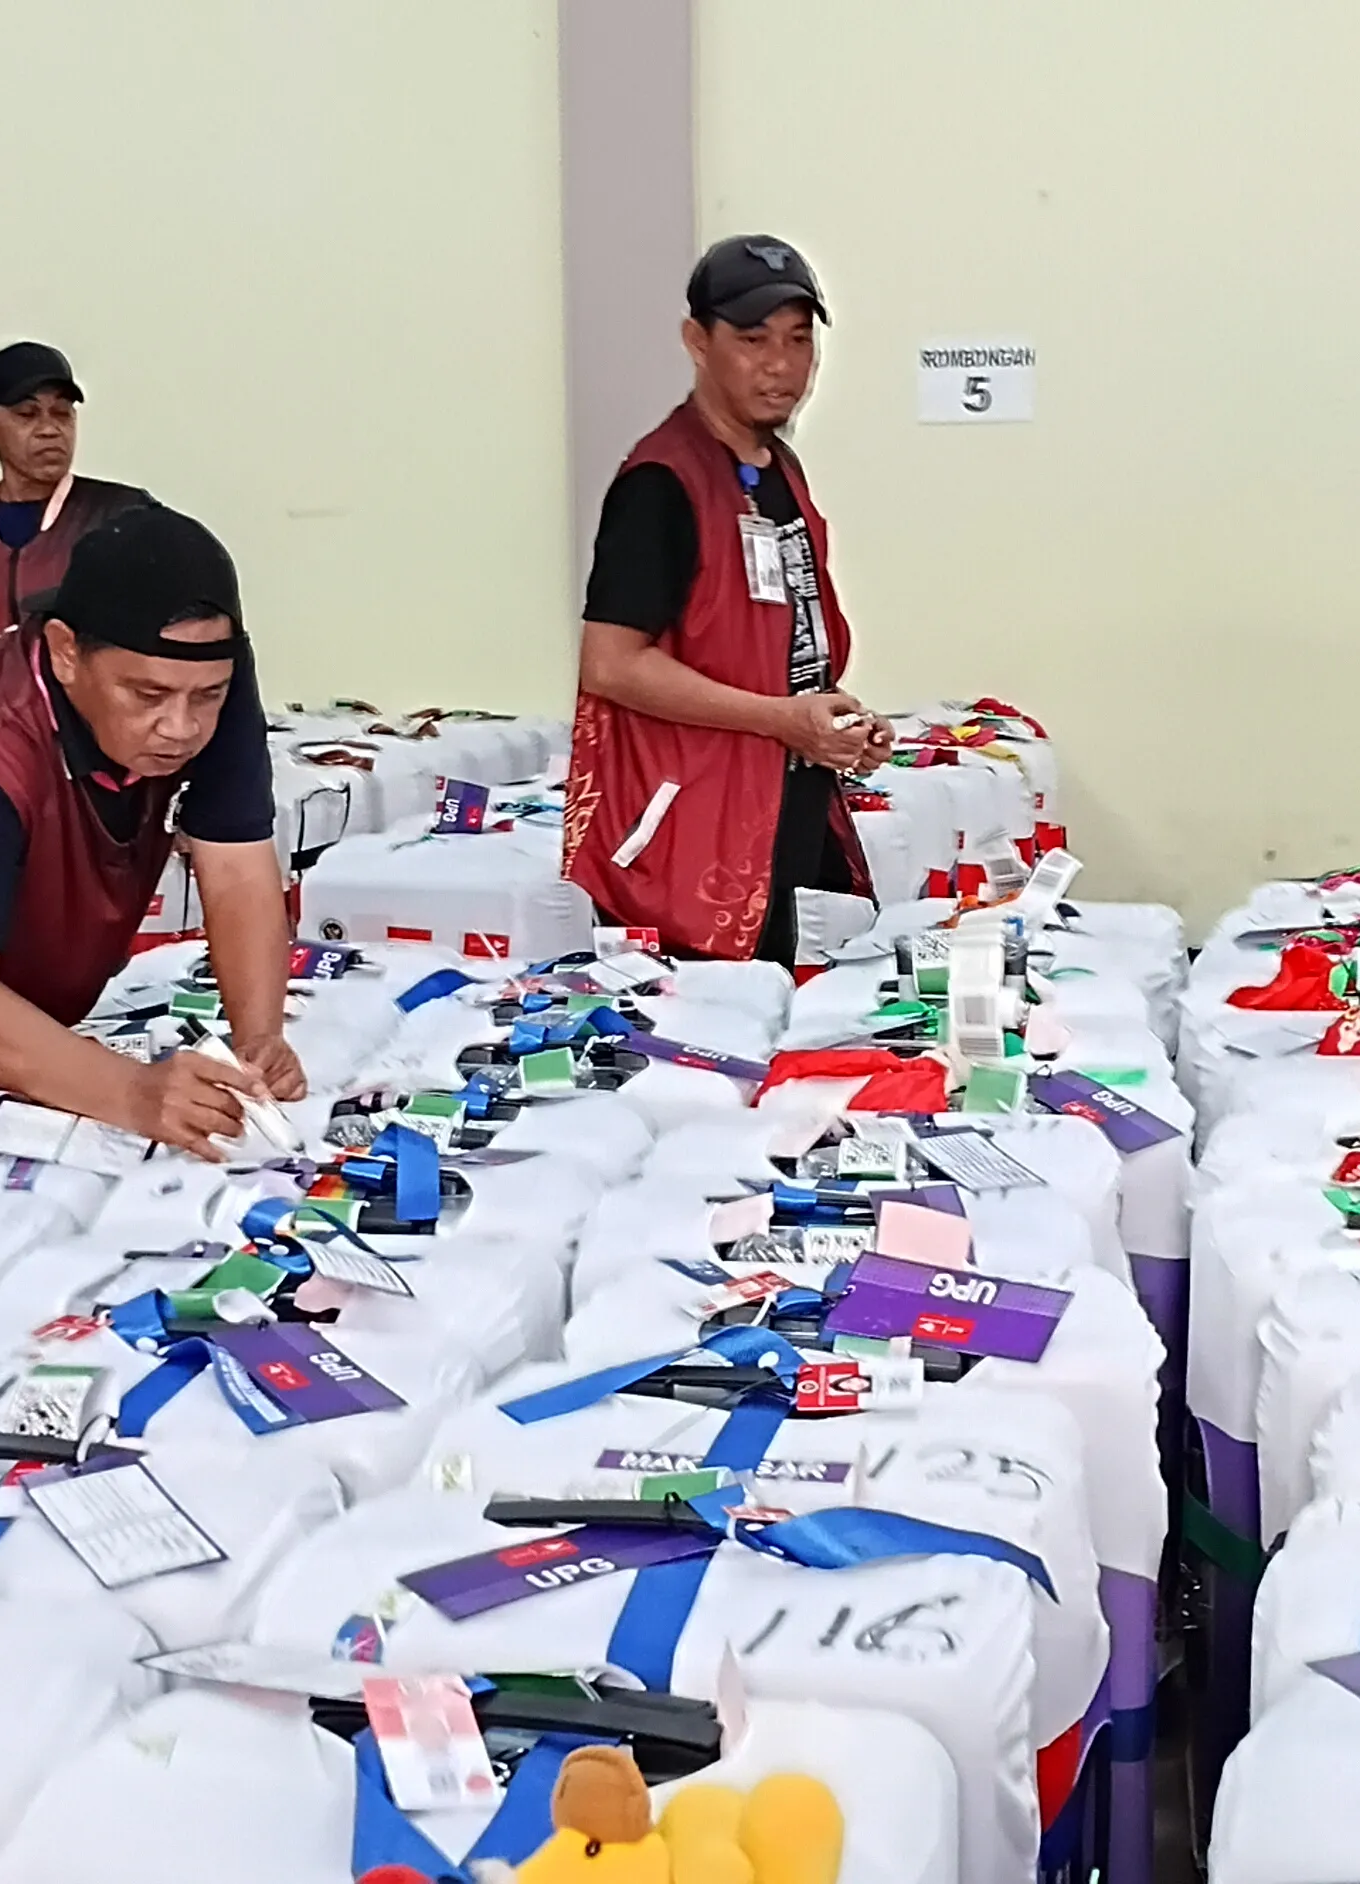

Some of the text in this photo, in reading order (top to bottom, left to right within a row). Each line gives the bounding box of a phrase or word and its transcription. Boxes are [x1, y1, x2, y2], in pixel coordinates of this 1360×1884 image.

[921, 348, 1036, 368] ROMBONGAN
[962, 376, 993, 412] 5
[1090, 1090, 1138, 1117] UPG
[928, 1272, 998, 1306] UPG
[308, 1352, 363, 1382] UPG
[524, 1557, 616, 1588] UPG
